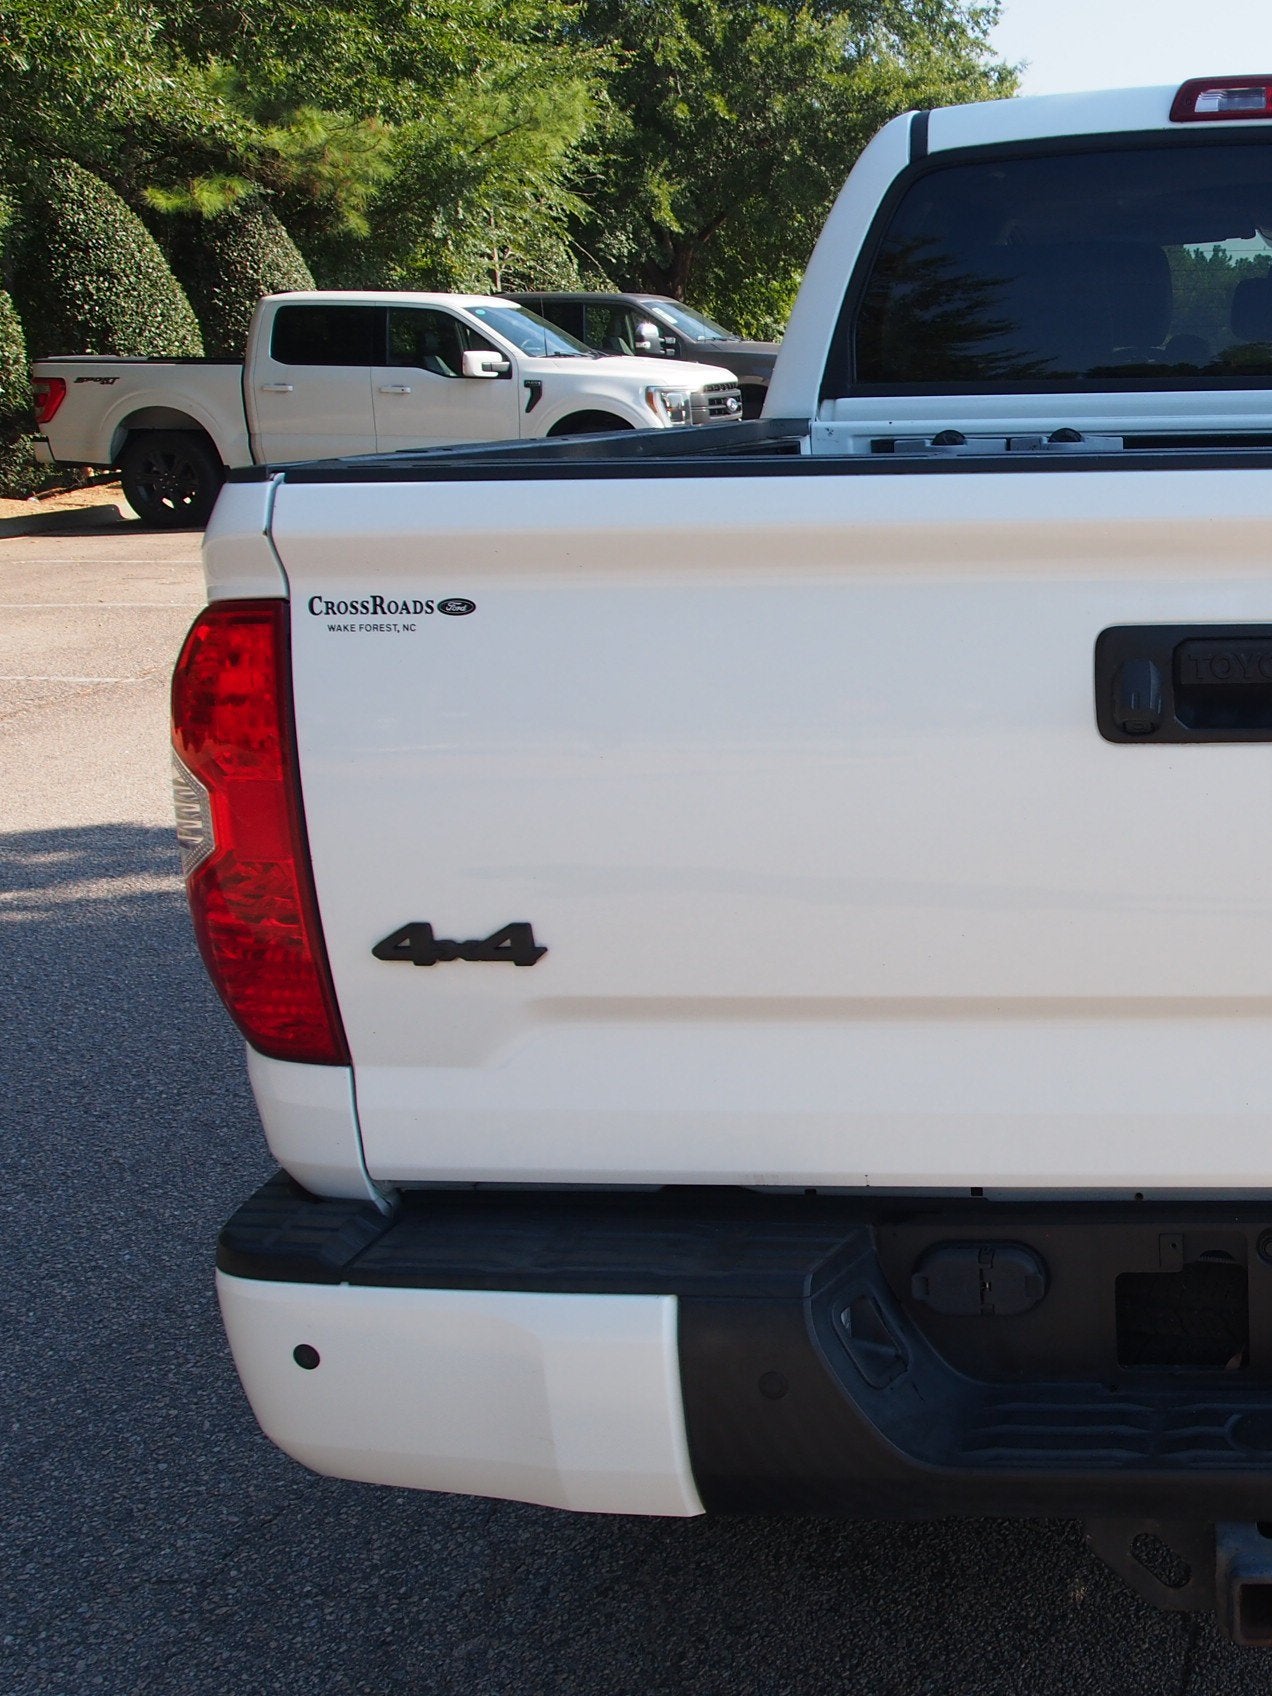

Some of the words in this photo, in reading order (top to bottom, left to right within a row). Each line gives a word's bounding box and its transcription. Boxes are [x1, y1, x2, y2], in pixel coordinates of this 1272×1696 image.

[327, 623, 356, 632] WAKE
[358, 623, 400, 633] FOREST,
[402, 623, 417, 632] NC
